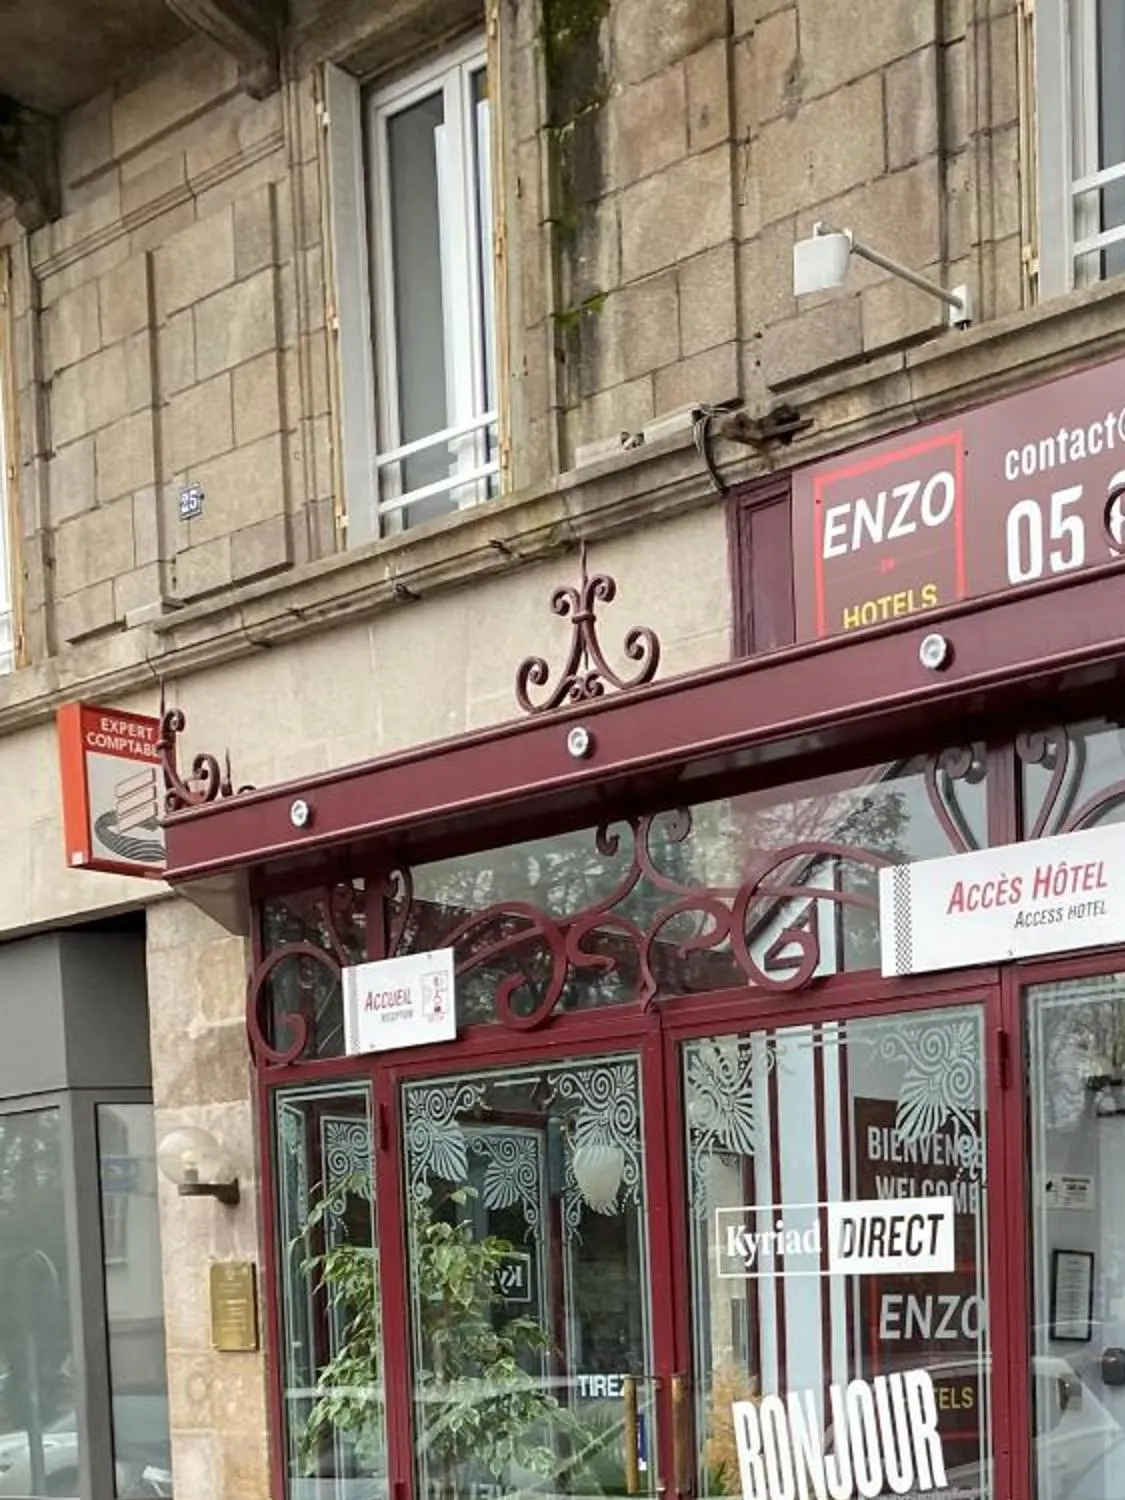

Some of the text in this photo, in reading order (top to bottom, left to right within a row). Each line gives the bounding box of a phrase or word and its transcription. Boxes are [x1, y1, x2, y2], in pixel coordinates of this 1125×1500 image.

[822, 470, 956, 560] ENZO
[1006, 484, 1086, 584] 05
[843, 582, 938, 629] HOTELS
[101, 717, 153, 740] EXPERT
[1013, 907, 1063, 929] ACCESS
[726, 1213, 945, 1267] Kyriad DIRECT
[879, 1294, 984, 1340] ENZO
